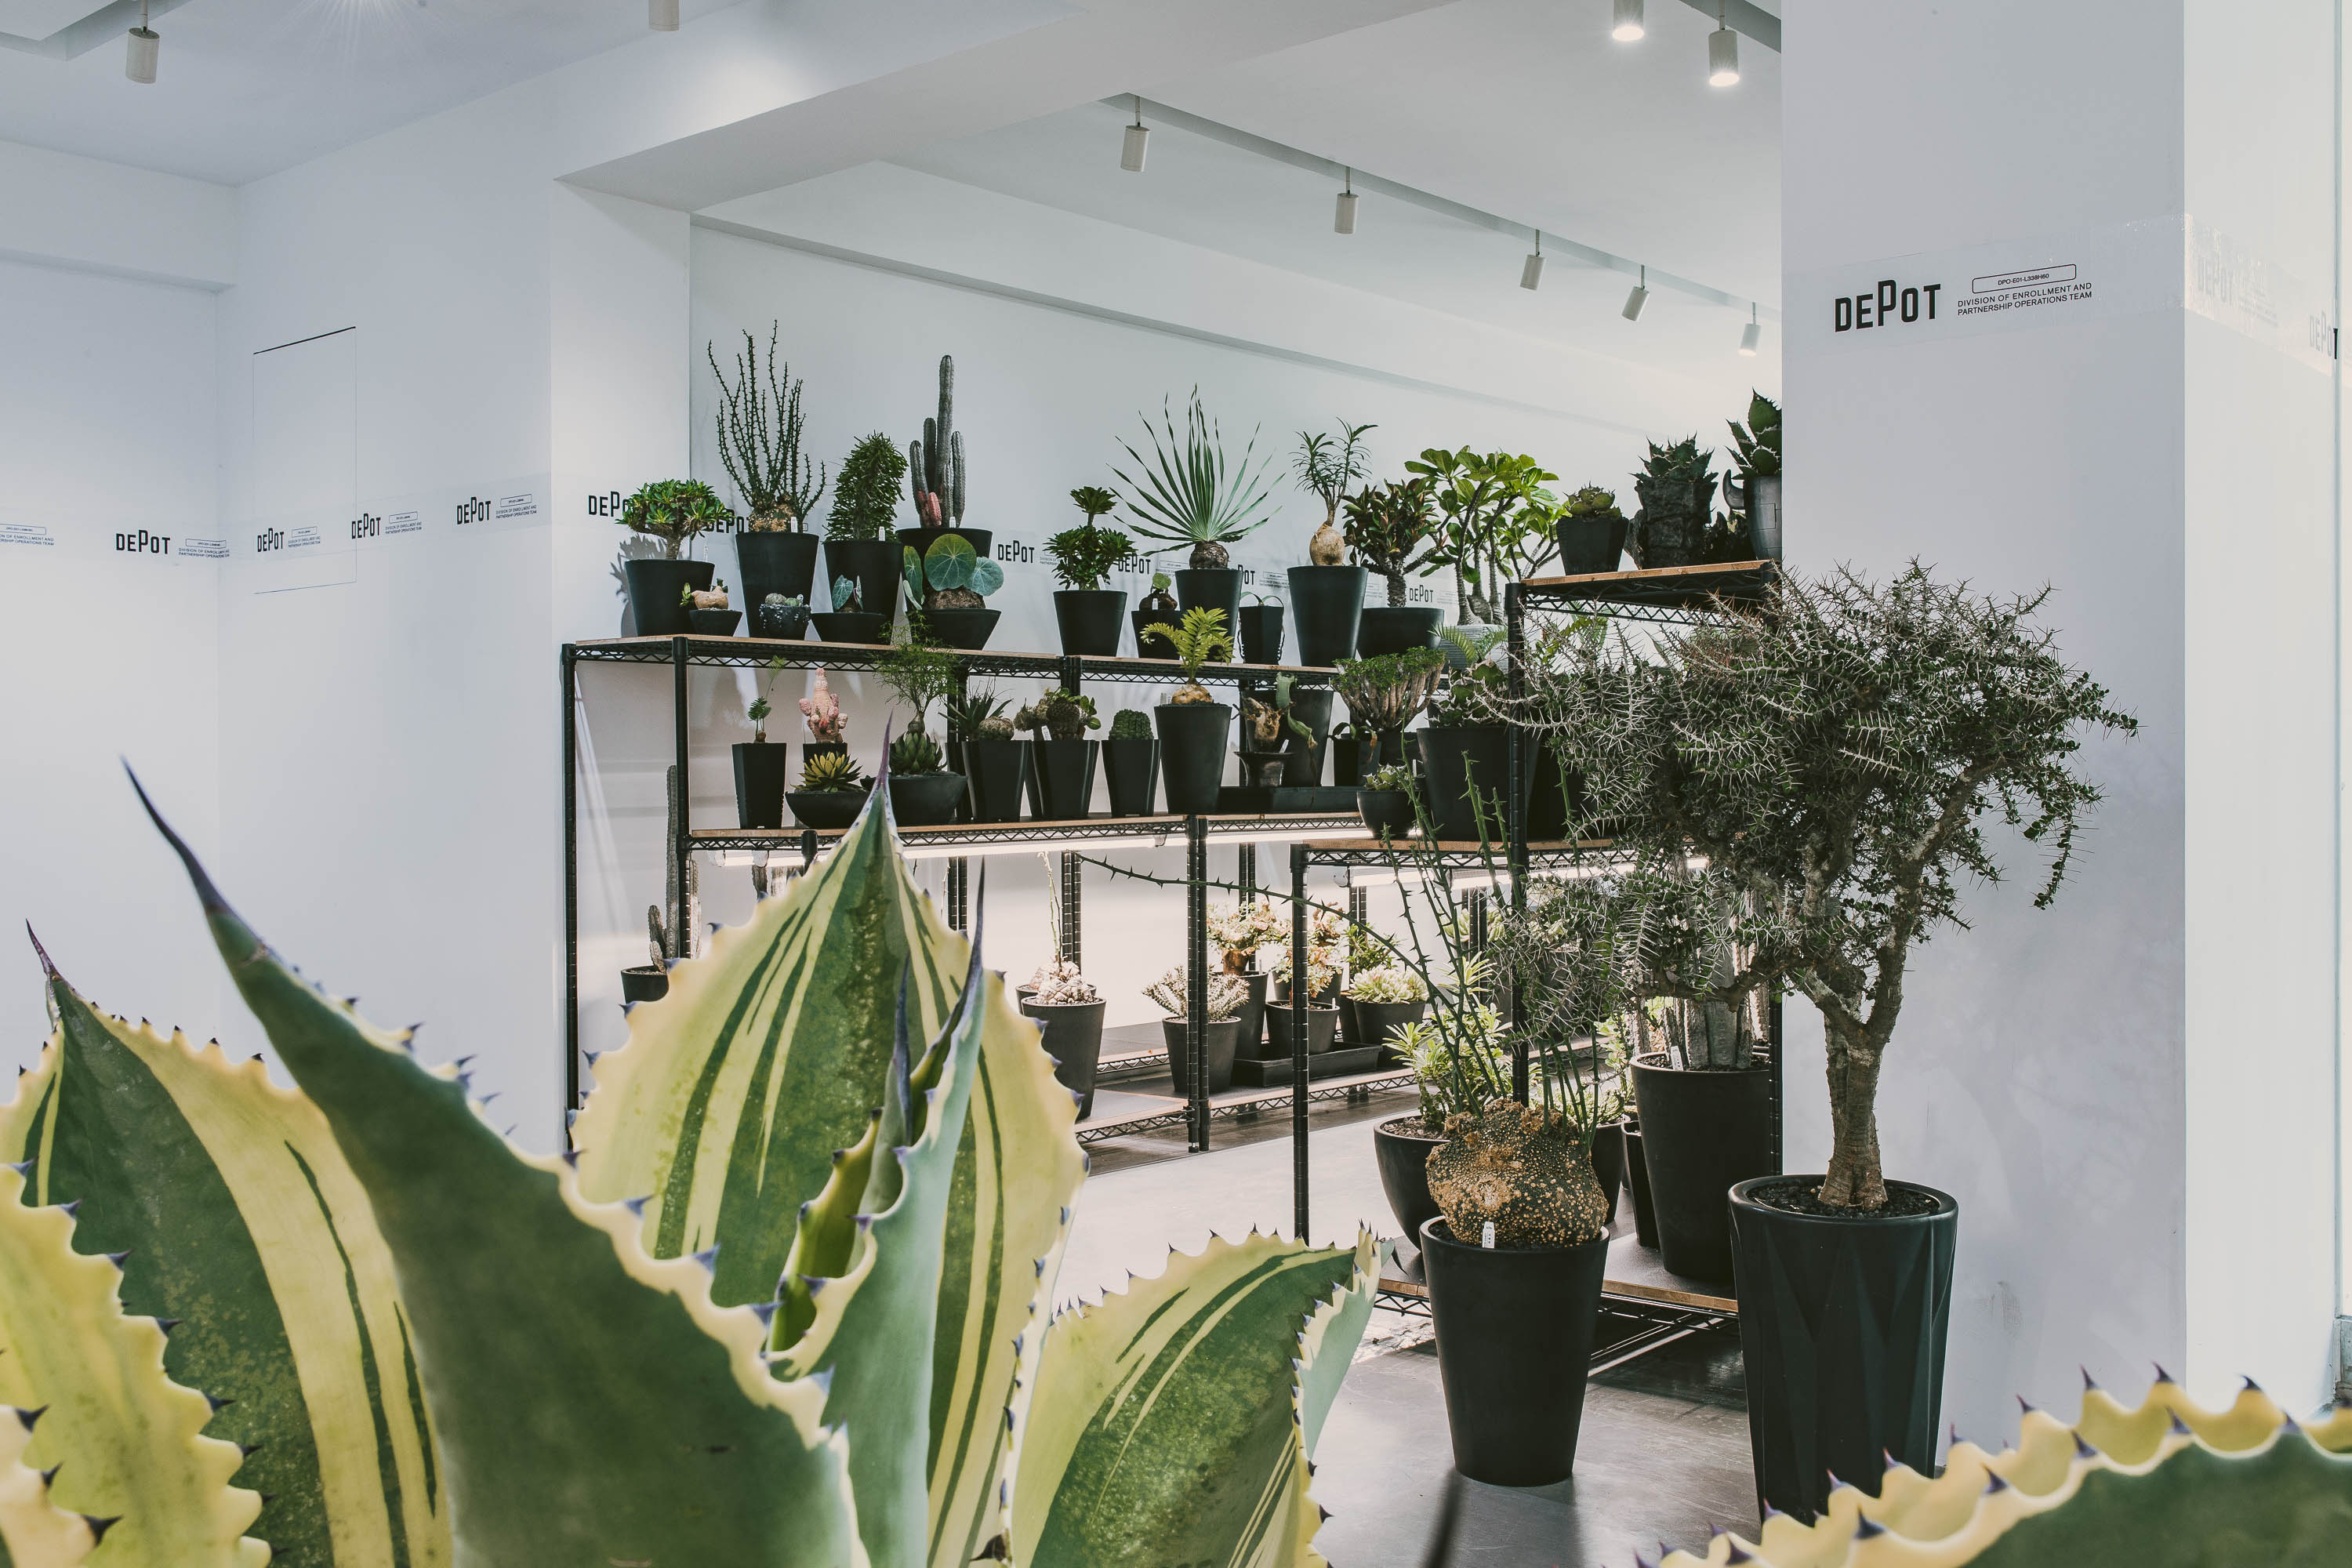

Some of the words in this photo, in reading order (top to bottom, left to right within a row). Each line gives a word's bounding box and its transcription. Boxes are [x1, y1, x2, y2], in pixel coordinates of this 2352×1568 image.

[1835, 280, 1940, 332] DEPOT
[1958, 296, 1995, 307] DIVISION
[2013, 285, 2071, 299] ENROLLMENT
[2073, 282, 2092, 291] AND
[1958, 303, 2013, 316] PARTNERSHIP
[2014, 295, 2067, 308] OPERATIONS
[2070, 292, 2092, 300] TEAM
[457, 496, 491, 524] DEPOT
[588, 491, 630, 517] DEP
[351, 513, 381, 539] DEPOT
[116, 529, 170, 554] DEPOT
[256, 528, 285, 553] DEPOT
[997, 539, 1035, 564] DEPOT
[1408, 584, 1434, 603] DEPOT
